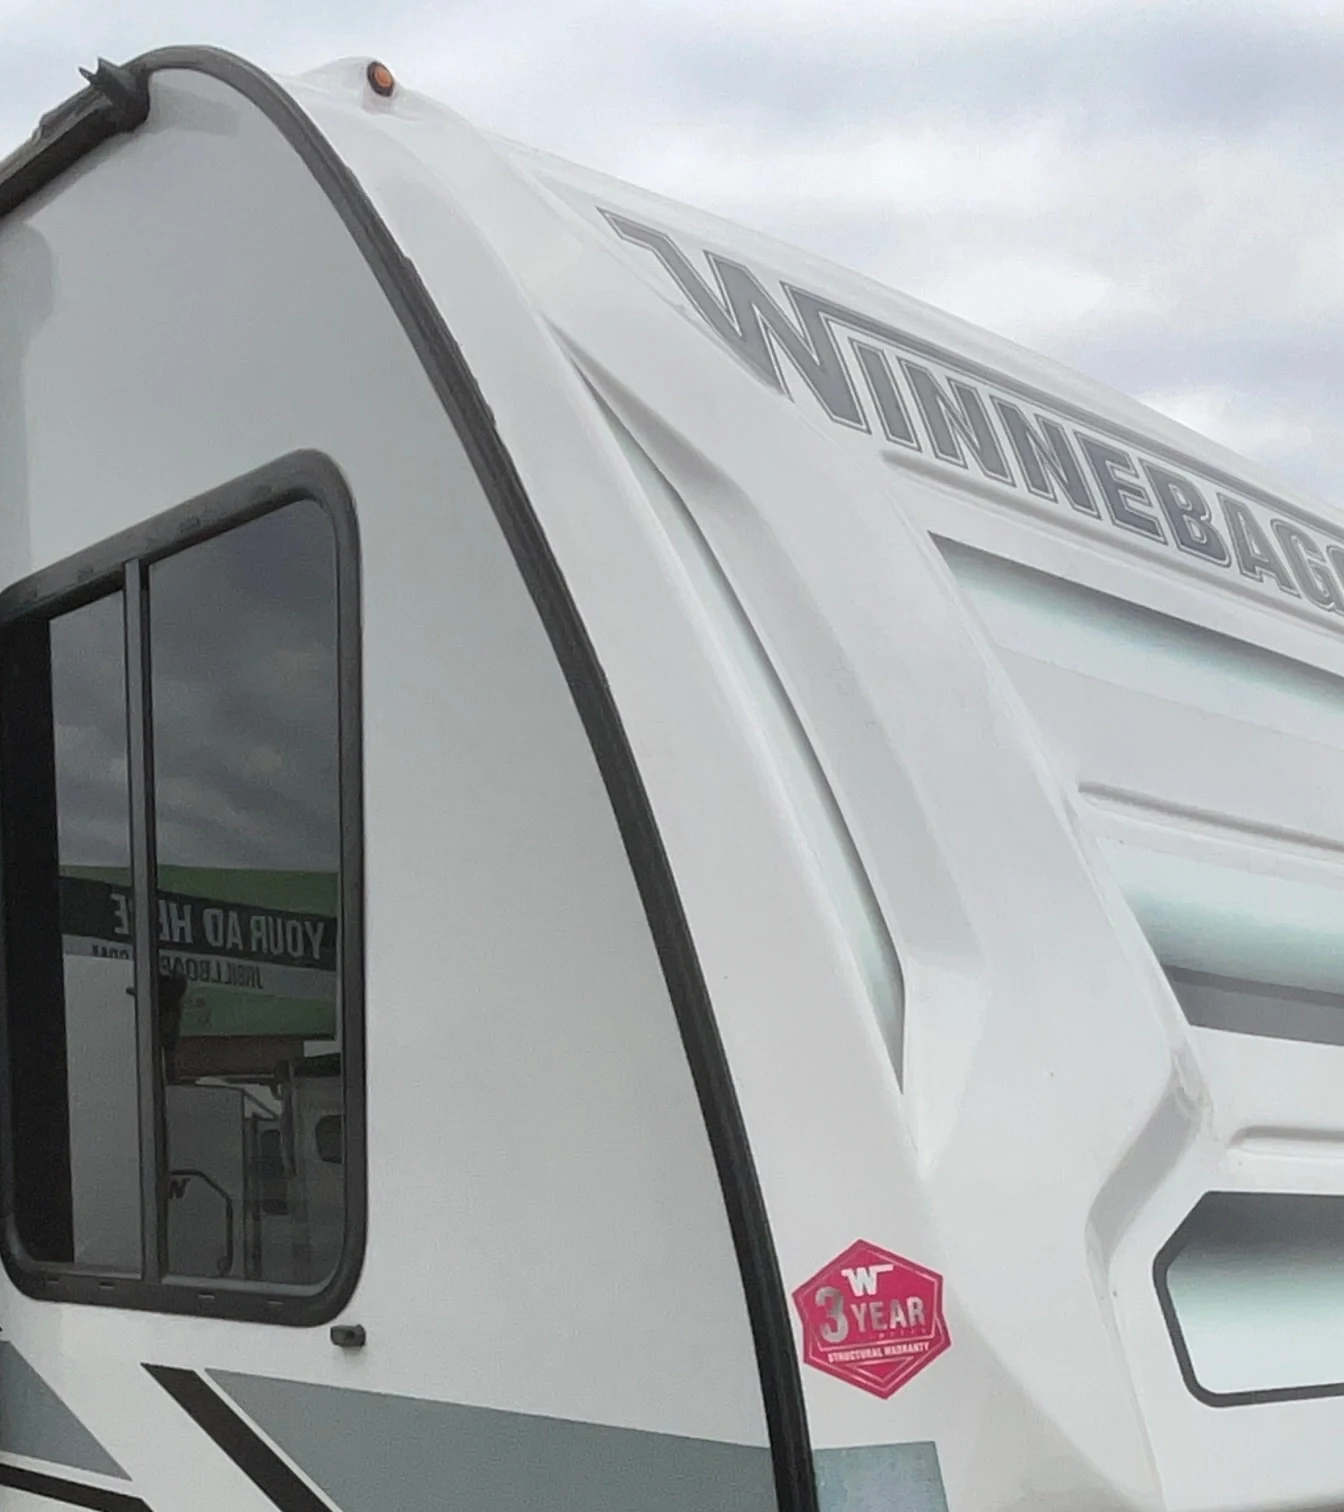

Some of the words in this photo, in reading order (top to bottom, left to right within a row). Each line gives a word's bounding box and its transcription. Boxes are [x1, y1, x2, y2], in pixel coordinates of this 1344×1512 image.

[815, 1286, 849, 1343] 3
[850, 1296, 926, 1333] YEAR
[827, 1347, 884, 1364] STRUCTURAL
[884, 1341, 931, 1357] WARRANTY
